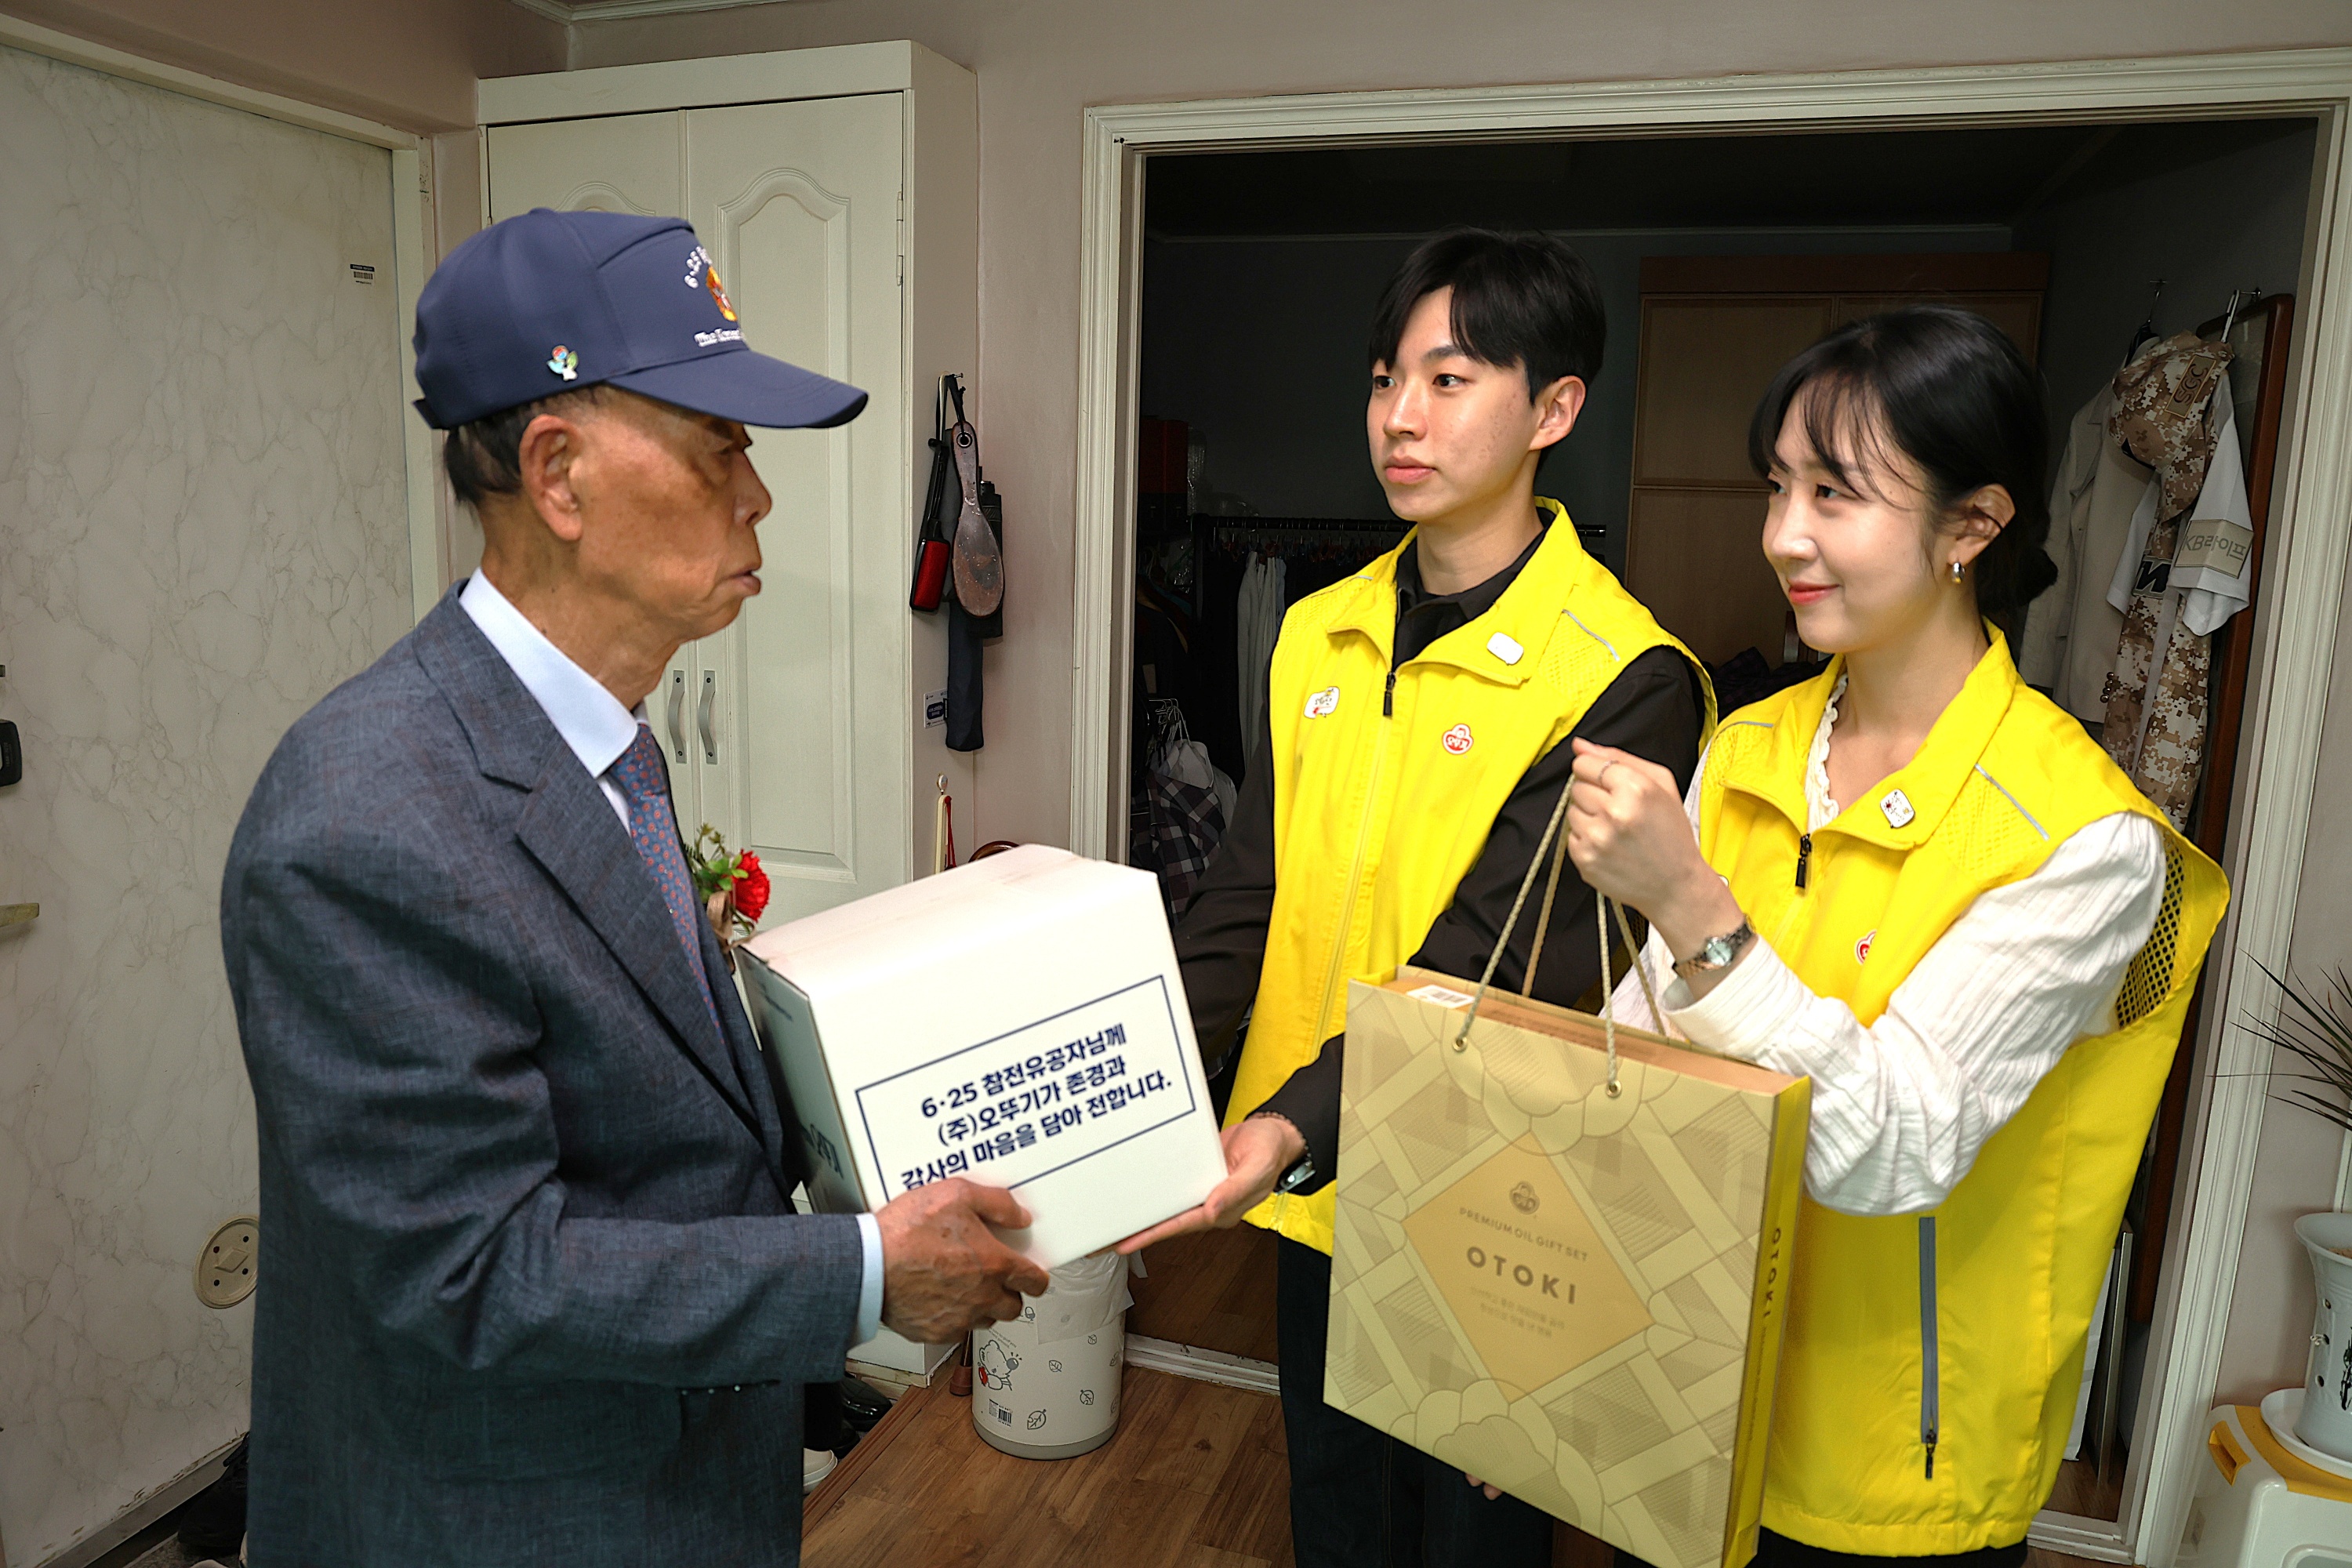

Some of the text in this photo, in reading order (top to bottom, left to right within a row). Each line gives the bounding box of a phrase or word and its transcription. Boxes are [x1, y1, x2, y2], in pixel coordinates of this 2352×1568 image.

[2173, 364, 2209, 406] SGC
[2182, 535, 2246, 561] KB라이프
[982, 1023, 1127, 1098] 참전유공자님께
[901, 1070, 1173, 1191] 감사의 마음을 담아 전합니다.
[937, 1055, 1127, 1147] (주)오뚜기가 존경과
[1459, 1207, 1588, 1263] PREMIUM OIL GIFT SET
[1466, 1246, 1577, 1305] OTOKI
[1762, 1227, 1781, 1319] OTOKI
